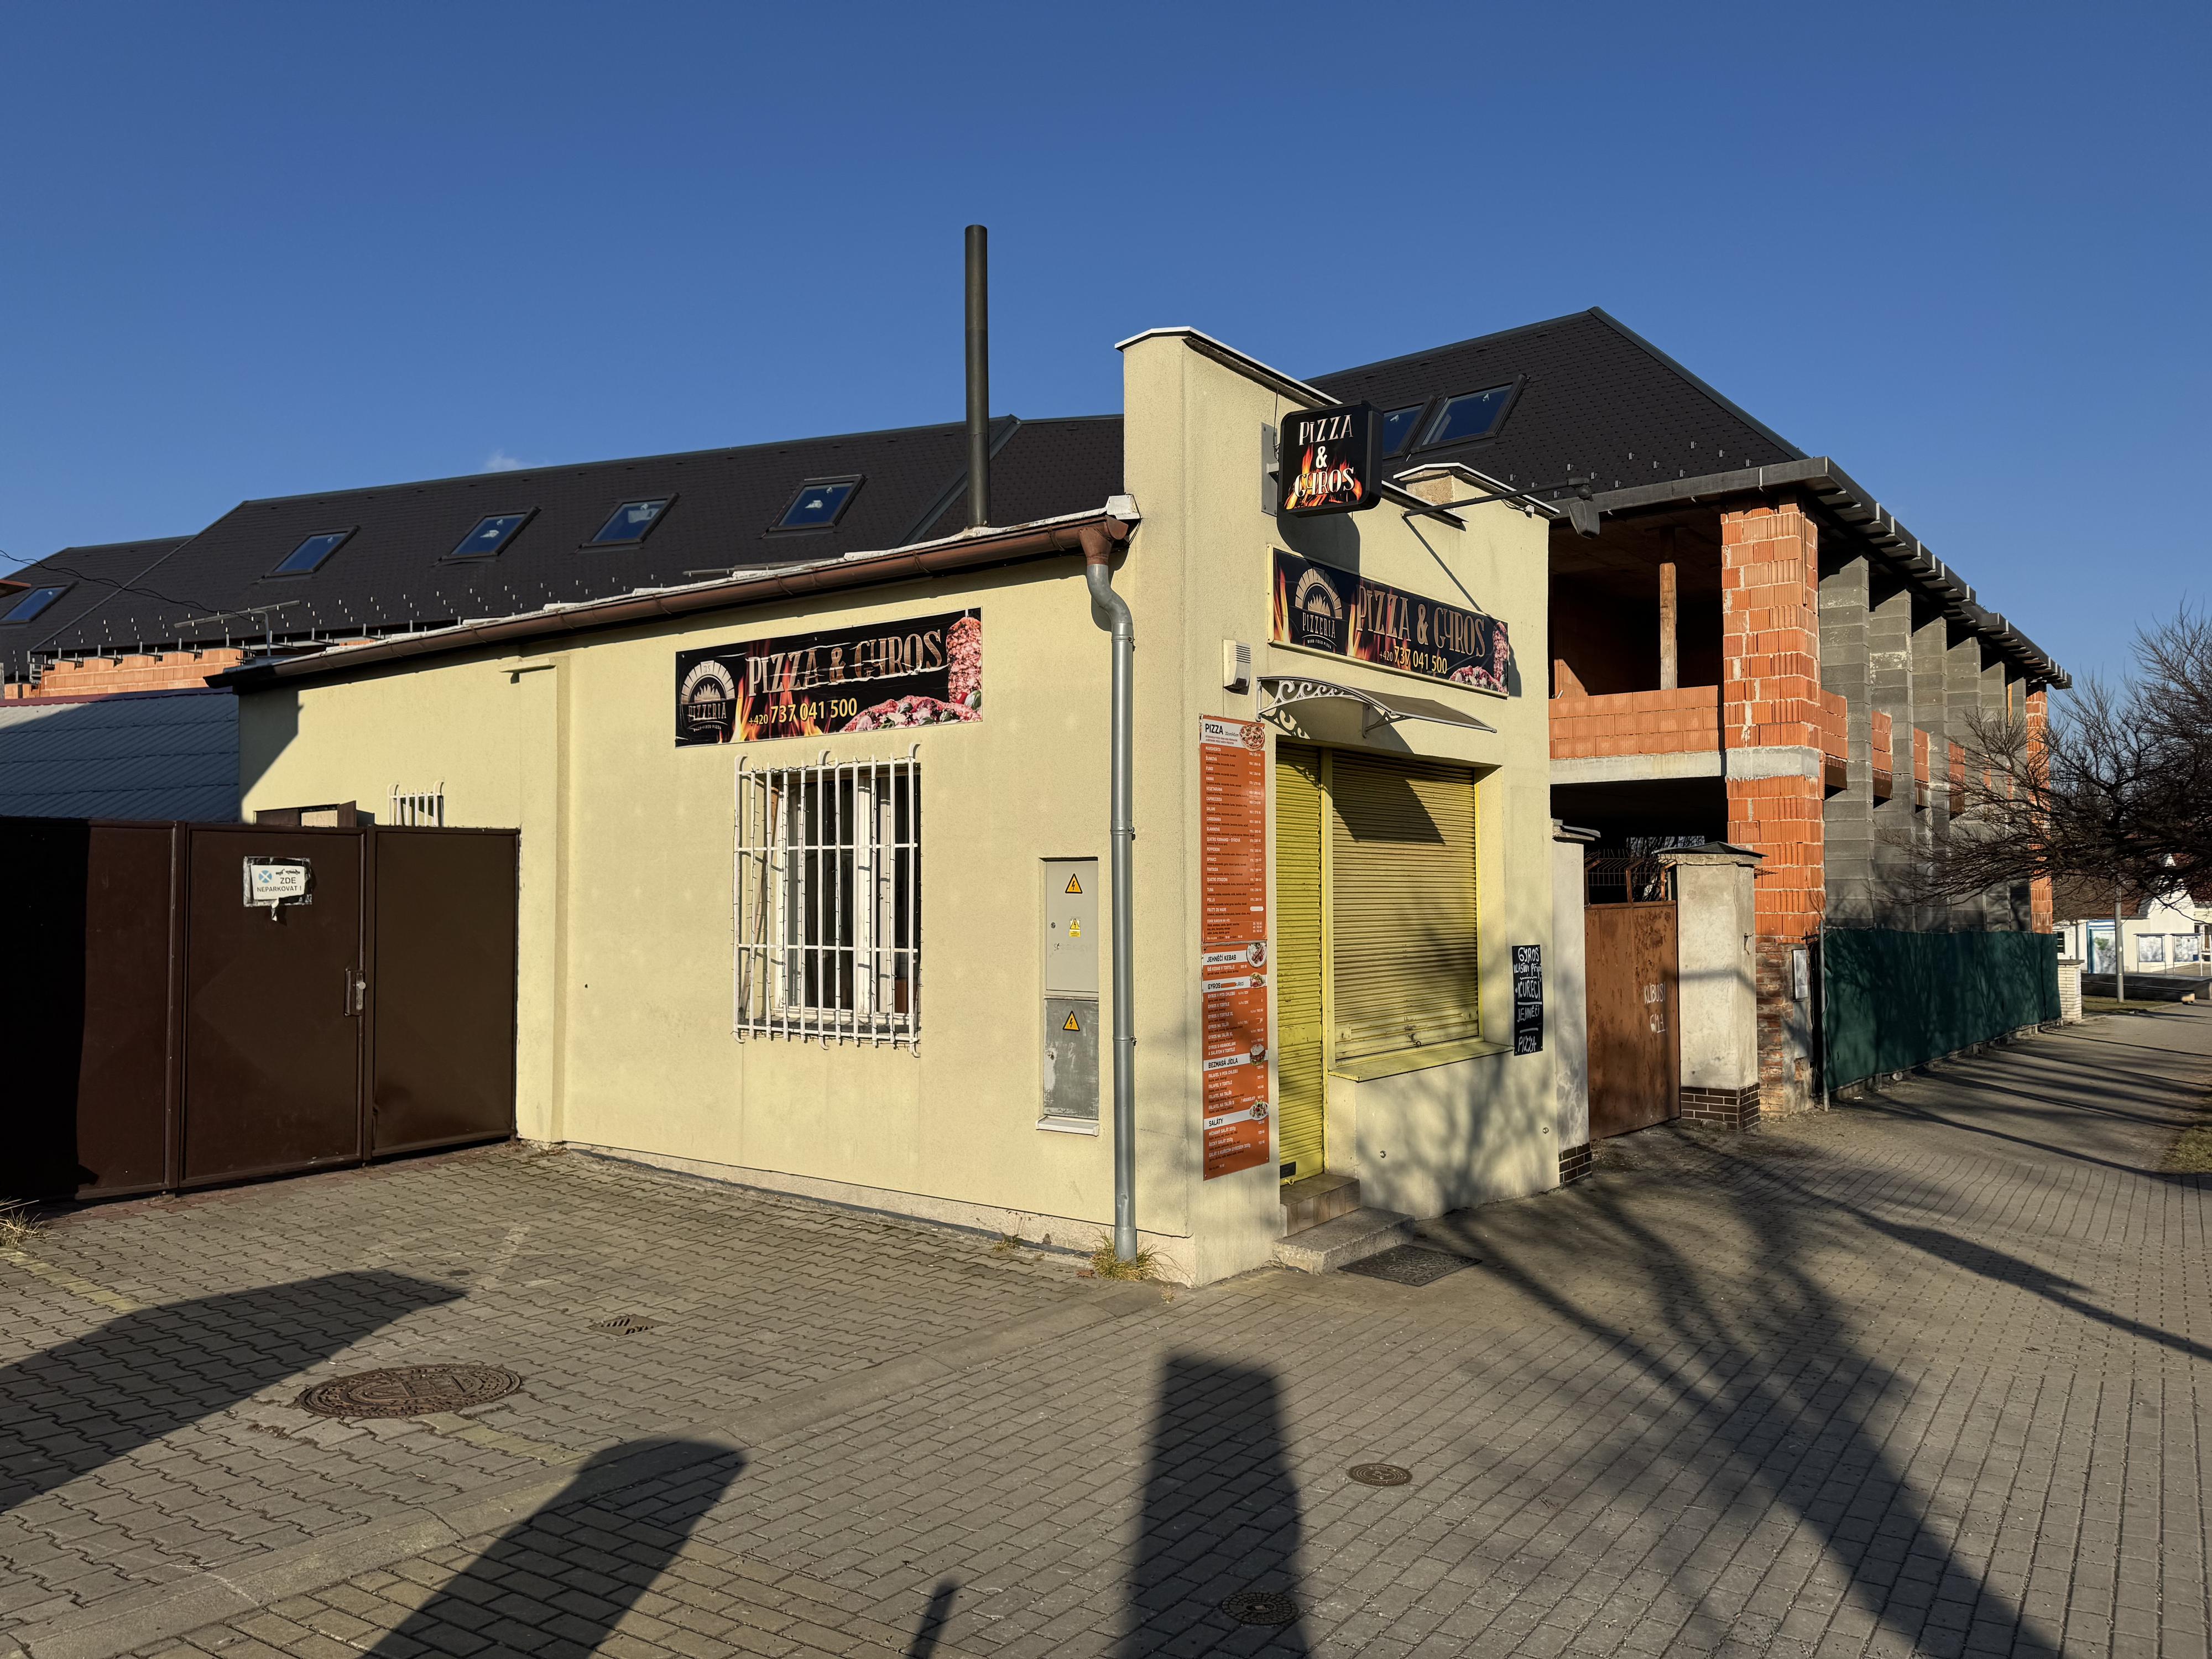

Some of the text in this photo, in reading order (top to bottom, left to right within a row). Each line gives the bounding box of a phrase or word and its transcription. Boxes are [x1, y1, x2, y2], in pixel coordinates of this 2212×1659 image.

[1299, 414, 1354, 446] PIZZA
[1316, 446, 1327, 469] &
[1295, 467, 1354, 497] GYROS
[1302, 612, 1335, 639] PIZZERIA
[1357, 585, 1485, 658] PIZZA & GYROS
[748, 629, 942, 697] PIZZA & GYROS
[1380, 646, 1447, 674] +420 737 041 500
[688, 702, 727, 722] PIZZERIA
[749, 698, 858, 725] +420 737 041 500
[1205, 723, 1224, 735] PIZZA
[1207, 954, 1223, 963] JEHNĚČÍ
[1518, 947, 1540, 962] GYROS
[1517, 1035, 1537, 1053] PIZZA
[1208, 1058, 1227, 1068] BEZMASÁ
[1209, 1118, 1223, 1126] SALÁTY
